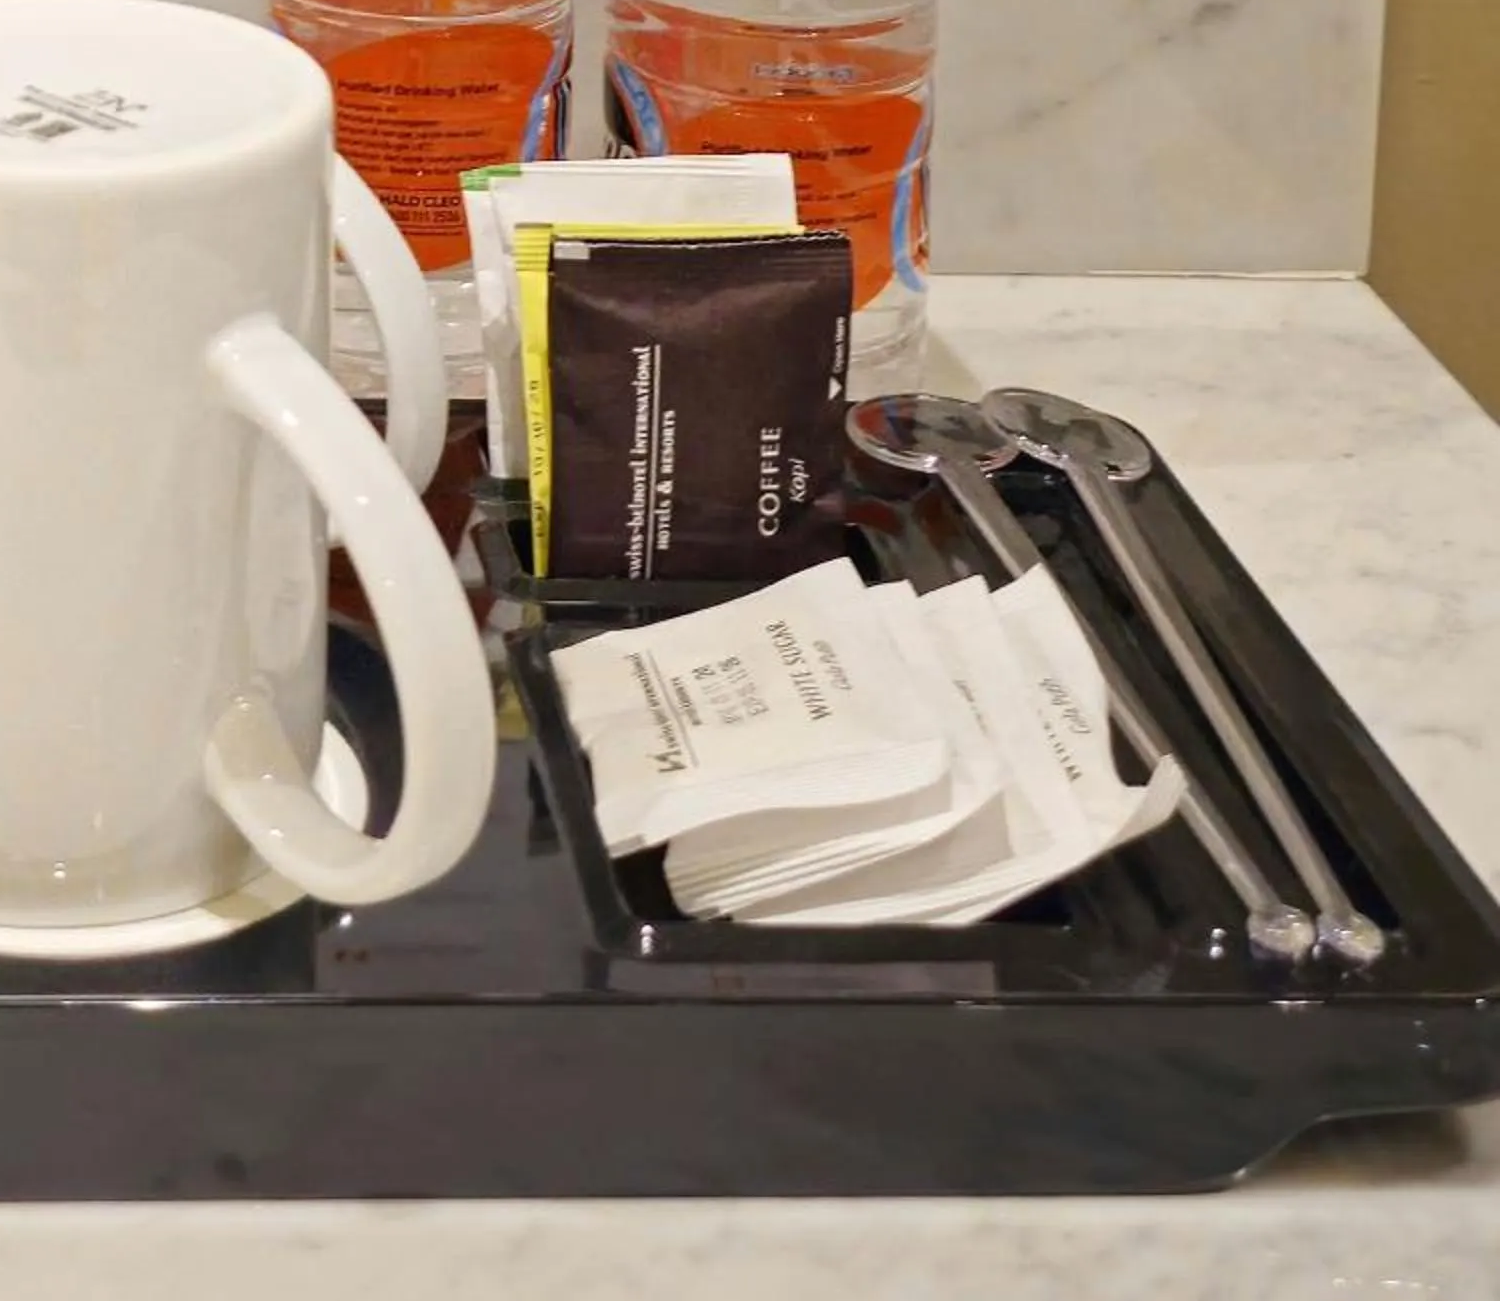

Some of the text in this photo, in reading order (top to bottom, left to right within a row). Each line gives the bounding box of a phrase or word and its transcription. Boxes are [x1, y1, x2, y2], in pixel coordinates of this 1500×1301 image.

[337, 79, 499, 98] Purified Drinking Water
[423, 196, 461, 208] CLEO
[659, 410, 676, 475] RESORTS
[656, 478, 673, 495] &
[758, 426, 782, 537] COFFEE
[764, 618, 834, 721] WHITE SUGAR
